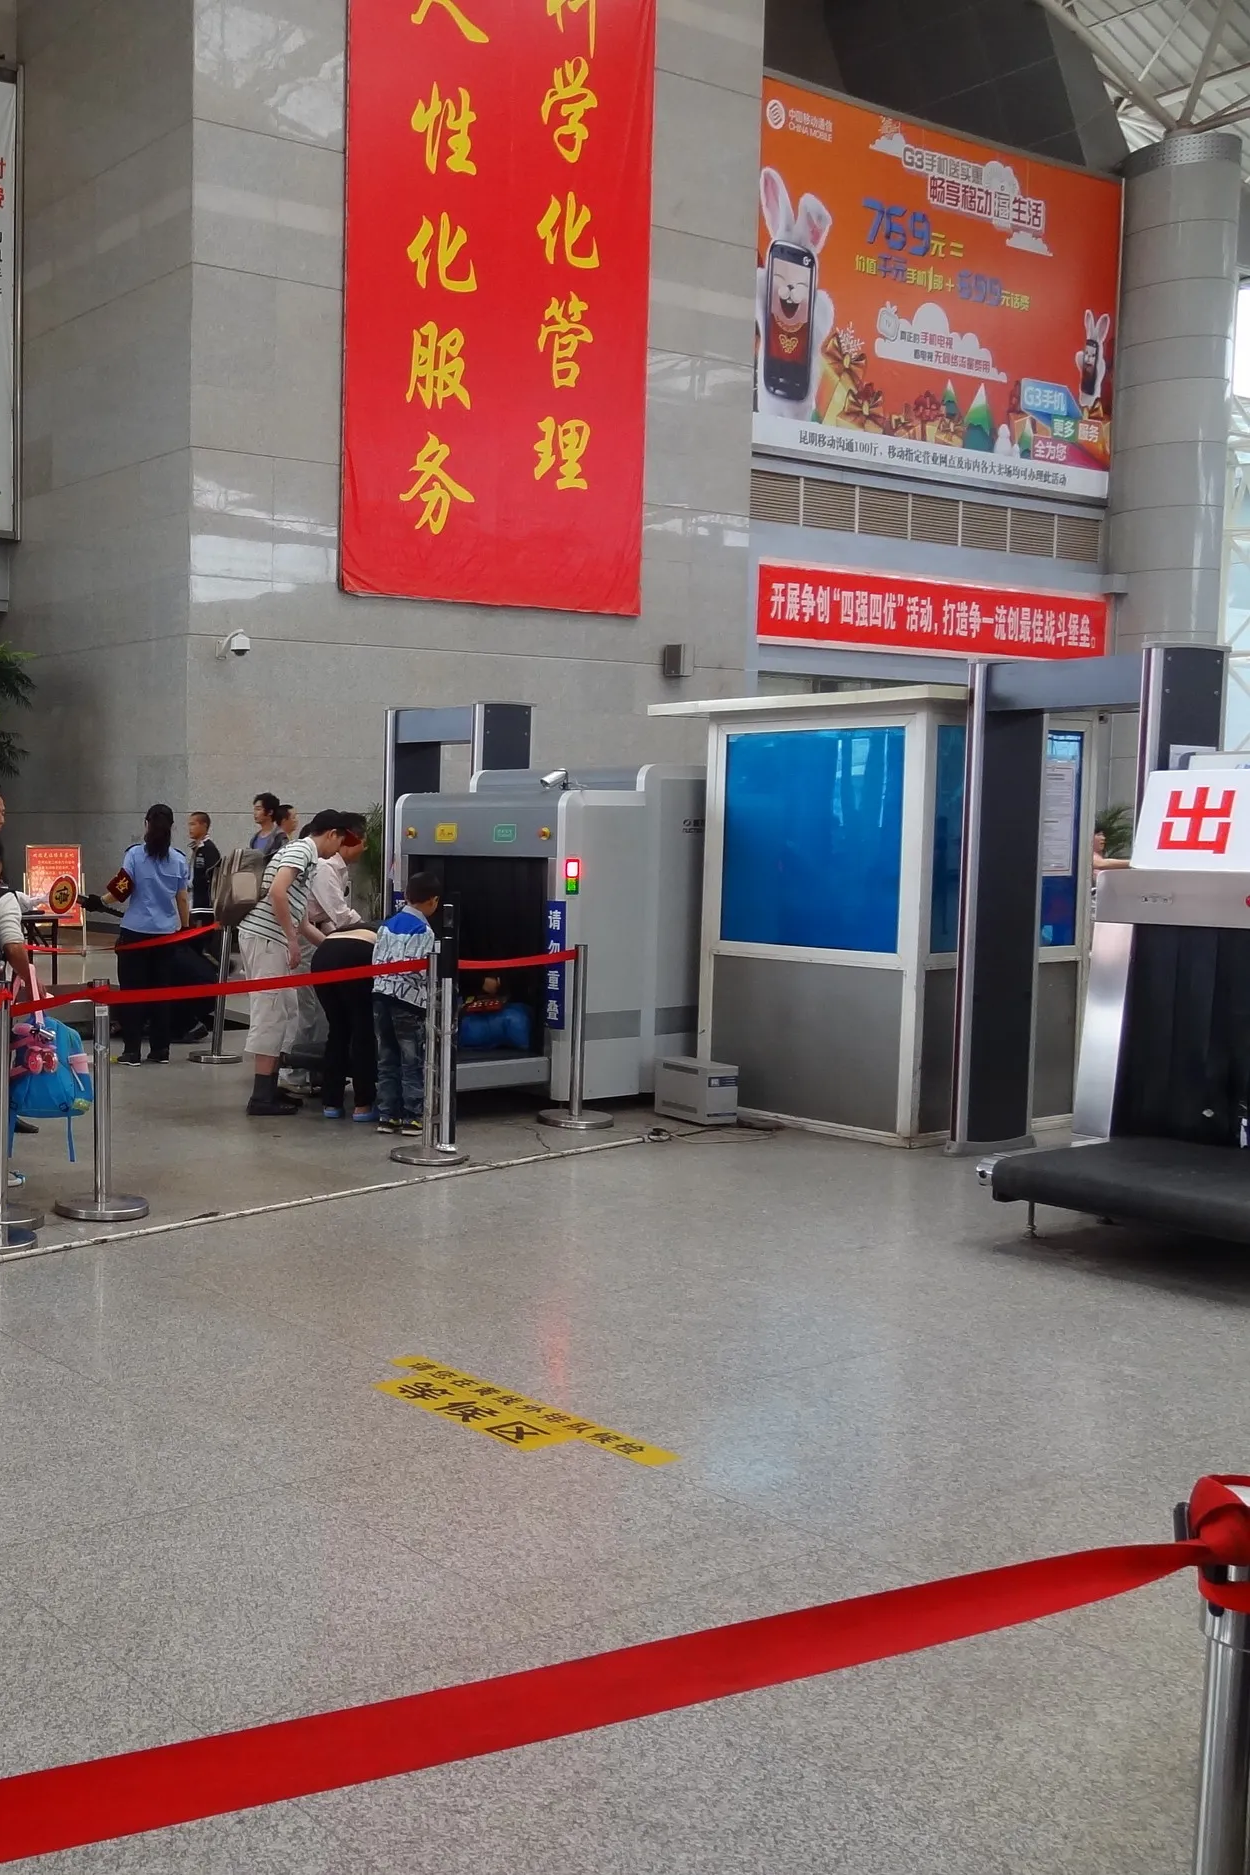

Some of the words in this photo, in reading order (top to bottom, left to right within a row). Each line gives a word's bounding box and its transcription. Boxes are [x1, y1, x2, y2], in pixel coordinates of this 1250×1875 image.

[1034, 442, 1068, 461] 全为您
[1053, 418, 1076, 438] 更多
[1079, 423, 1099, 443] 服务
[1157, 787, 1236, 854] 出
[547, 910, 561, 1020] 请勿重叠
[398, 1381, 551, 1444] 等候区
[408, 1361, 645, 1455] 请您在黄线外排队候检
